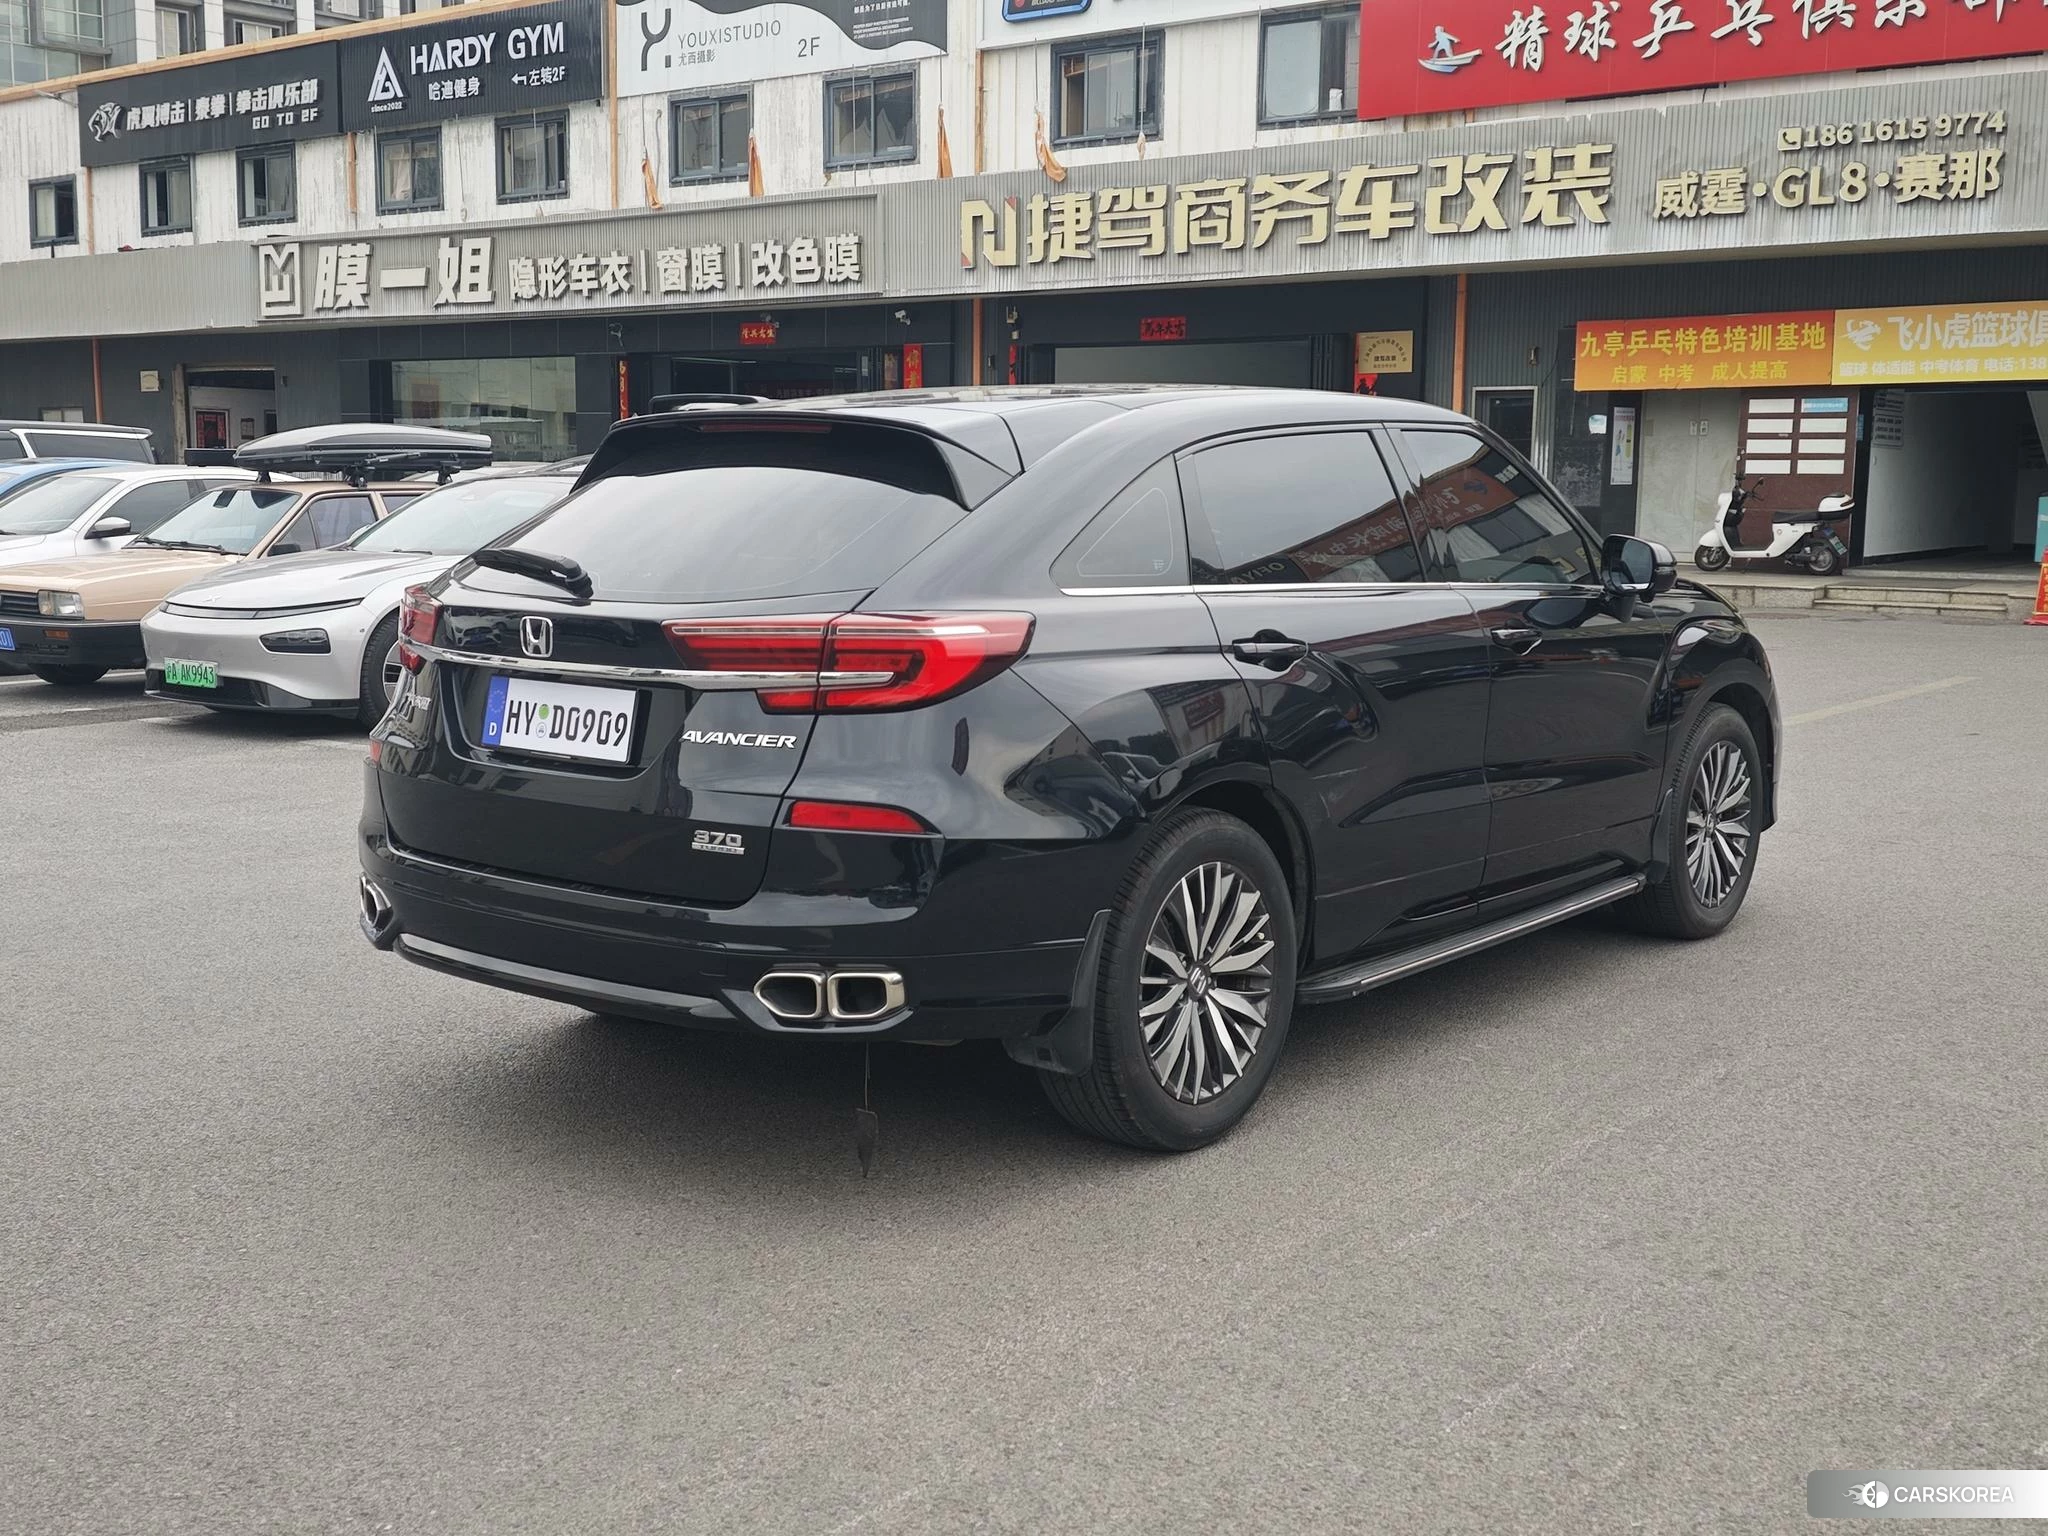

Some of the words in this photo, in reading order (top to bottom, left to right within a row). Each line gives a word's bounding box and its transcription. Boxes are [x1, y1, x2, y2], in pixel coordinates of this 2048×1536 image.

[677, 19, 781, 49] YOUXISTUDIO
[410, 32, 496, 75] HARDY
[508, 21, 565, 60] GYM
[678, 49, 716, 67] 尤西摄影
[797, 36, 820, 58] 2F
[428, 76, 481, 101] 哈迪健身
[528, 66, 566, 87] 左转2F
[236, 78, 318, 115] 拳击俱乐部
[252, 115, 270, 130] GO
[278, 111, 294, 126] TO
[301, 107, 318, 122] 2F
[1804, 120, 1854, 149] 186
[1860, 115, 1929, 144] 1615
[1934, 109, 2007, 137] 9774
[1026, 143, 1614, 265] 捷驾商务车改装
[314, 236, 496, 311] 膜一姐
[508, 249, 633, 301] 隐形车衣
[656, 243, 726, 294] 窗膜
[751, 232, 863, 288] 改色膜
[1580, 320, 1827, 358] 九亭乒乓特色培训基地
[1611, 364, 1647, 384] 启蒙
[1658, 363, 1695, 383] 中考
[1711, 359, 1789, 381] 成人提高
[1839, 361, 1869, 377] 篮球
[1872, 359, 1916, 375] 体适能
[1920, 358, 1980, 375] 中考体育
[180, 663, 215, 684] AK9943
[488, 721, 498, 736] D
[506, 699, 538, 736] HY
[681, 730, 797, 748] AVANCIER
[693, 829, 742, 847] 370
